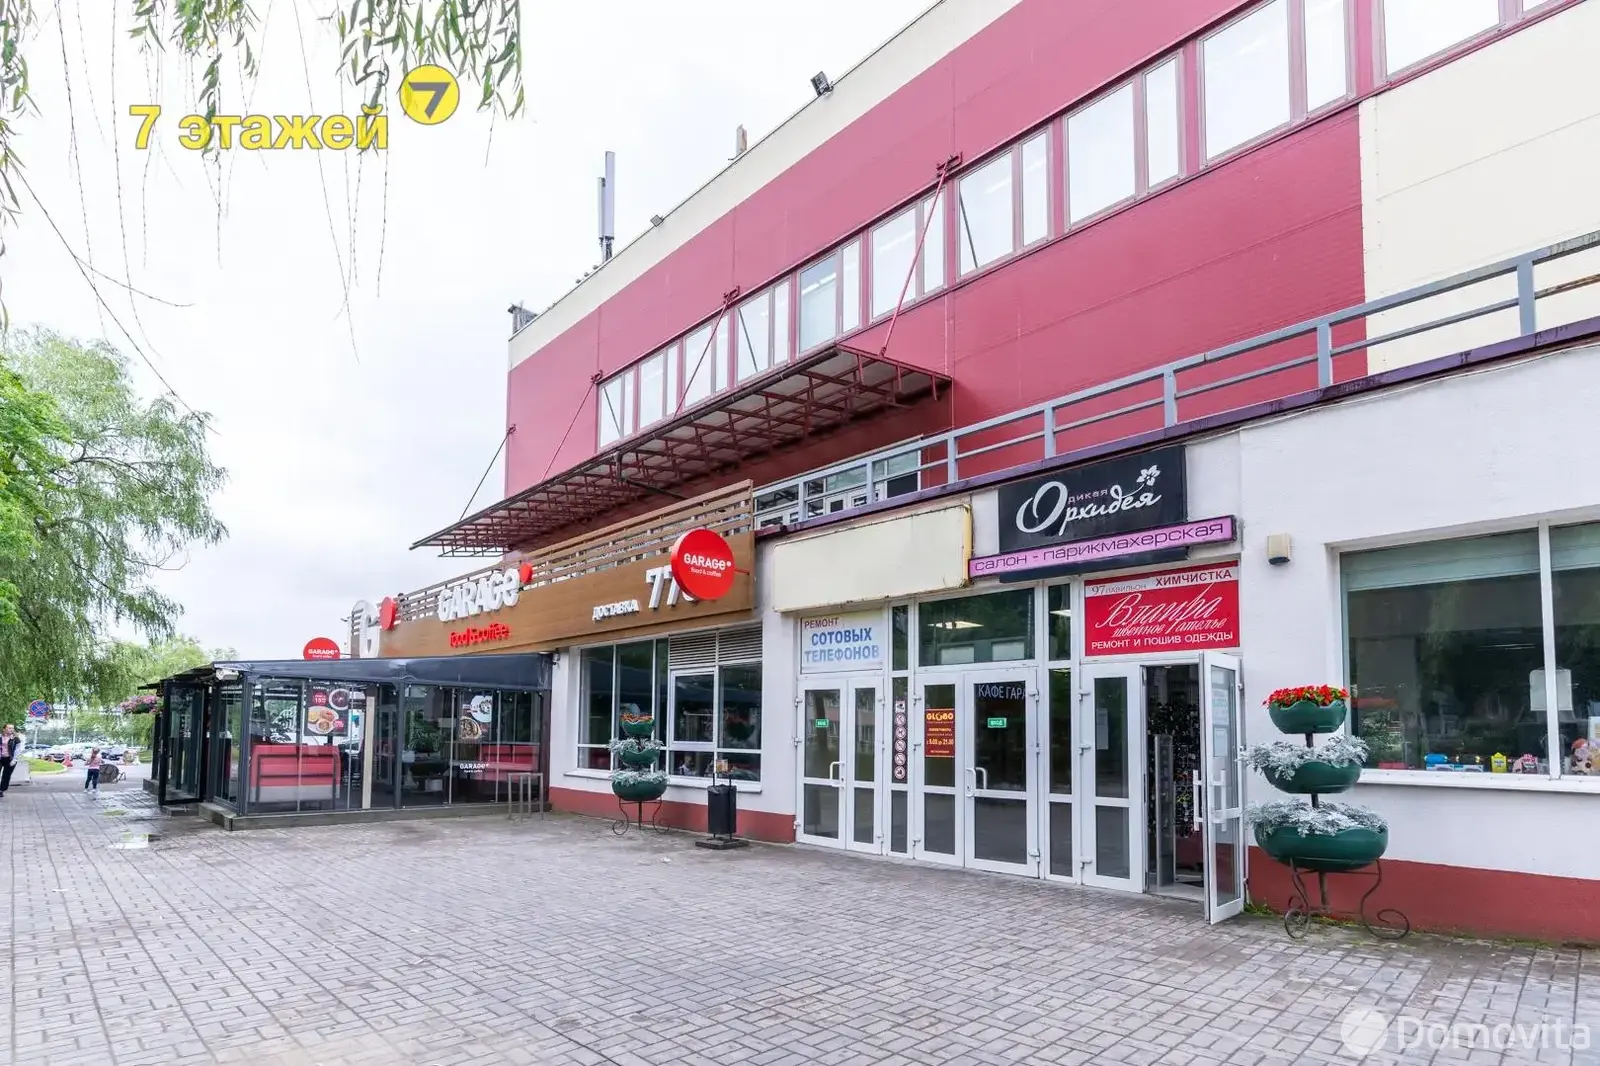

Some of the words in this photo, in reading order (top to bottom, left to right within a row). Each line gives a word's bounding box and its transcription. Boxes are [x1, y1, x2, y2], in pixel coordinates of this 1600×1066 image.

[1068, 488, 1109, 505] дикая
[974, 555, 1027, 572] салон
[1043, 521, 1223, 561] парикмахерская
[1155, 569, 1232, 587] ХИМЧИСТКА
[1091, 585, 1105, 595] 97
[804, 618, 838, 629] РЕМОНТ
[811, 627, 872, 646] СОТОВЫХ
[1091, 639, 1130, 650] РЕМОНТ
[1133, 637, 1141, 646] И
[1144, 634, 1182, 646] ПОШИВ
[1184, 631, 1233, 643] ОДЕЖДЫ
[804, 645, 880, 663] ТЕЛЕФОНОВ
[978, 684, 1004, 699] КАФЕ
[926, 712, 954, 721] GLOBO
